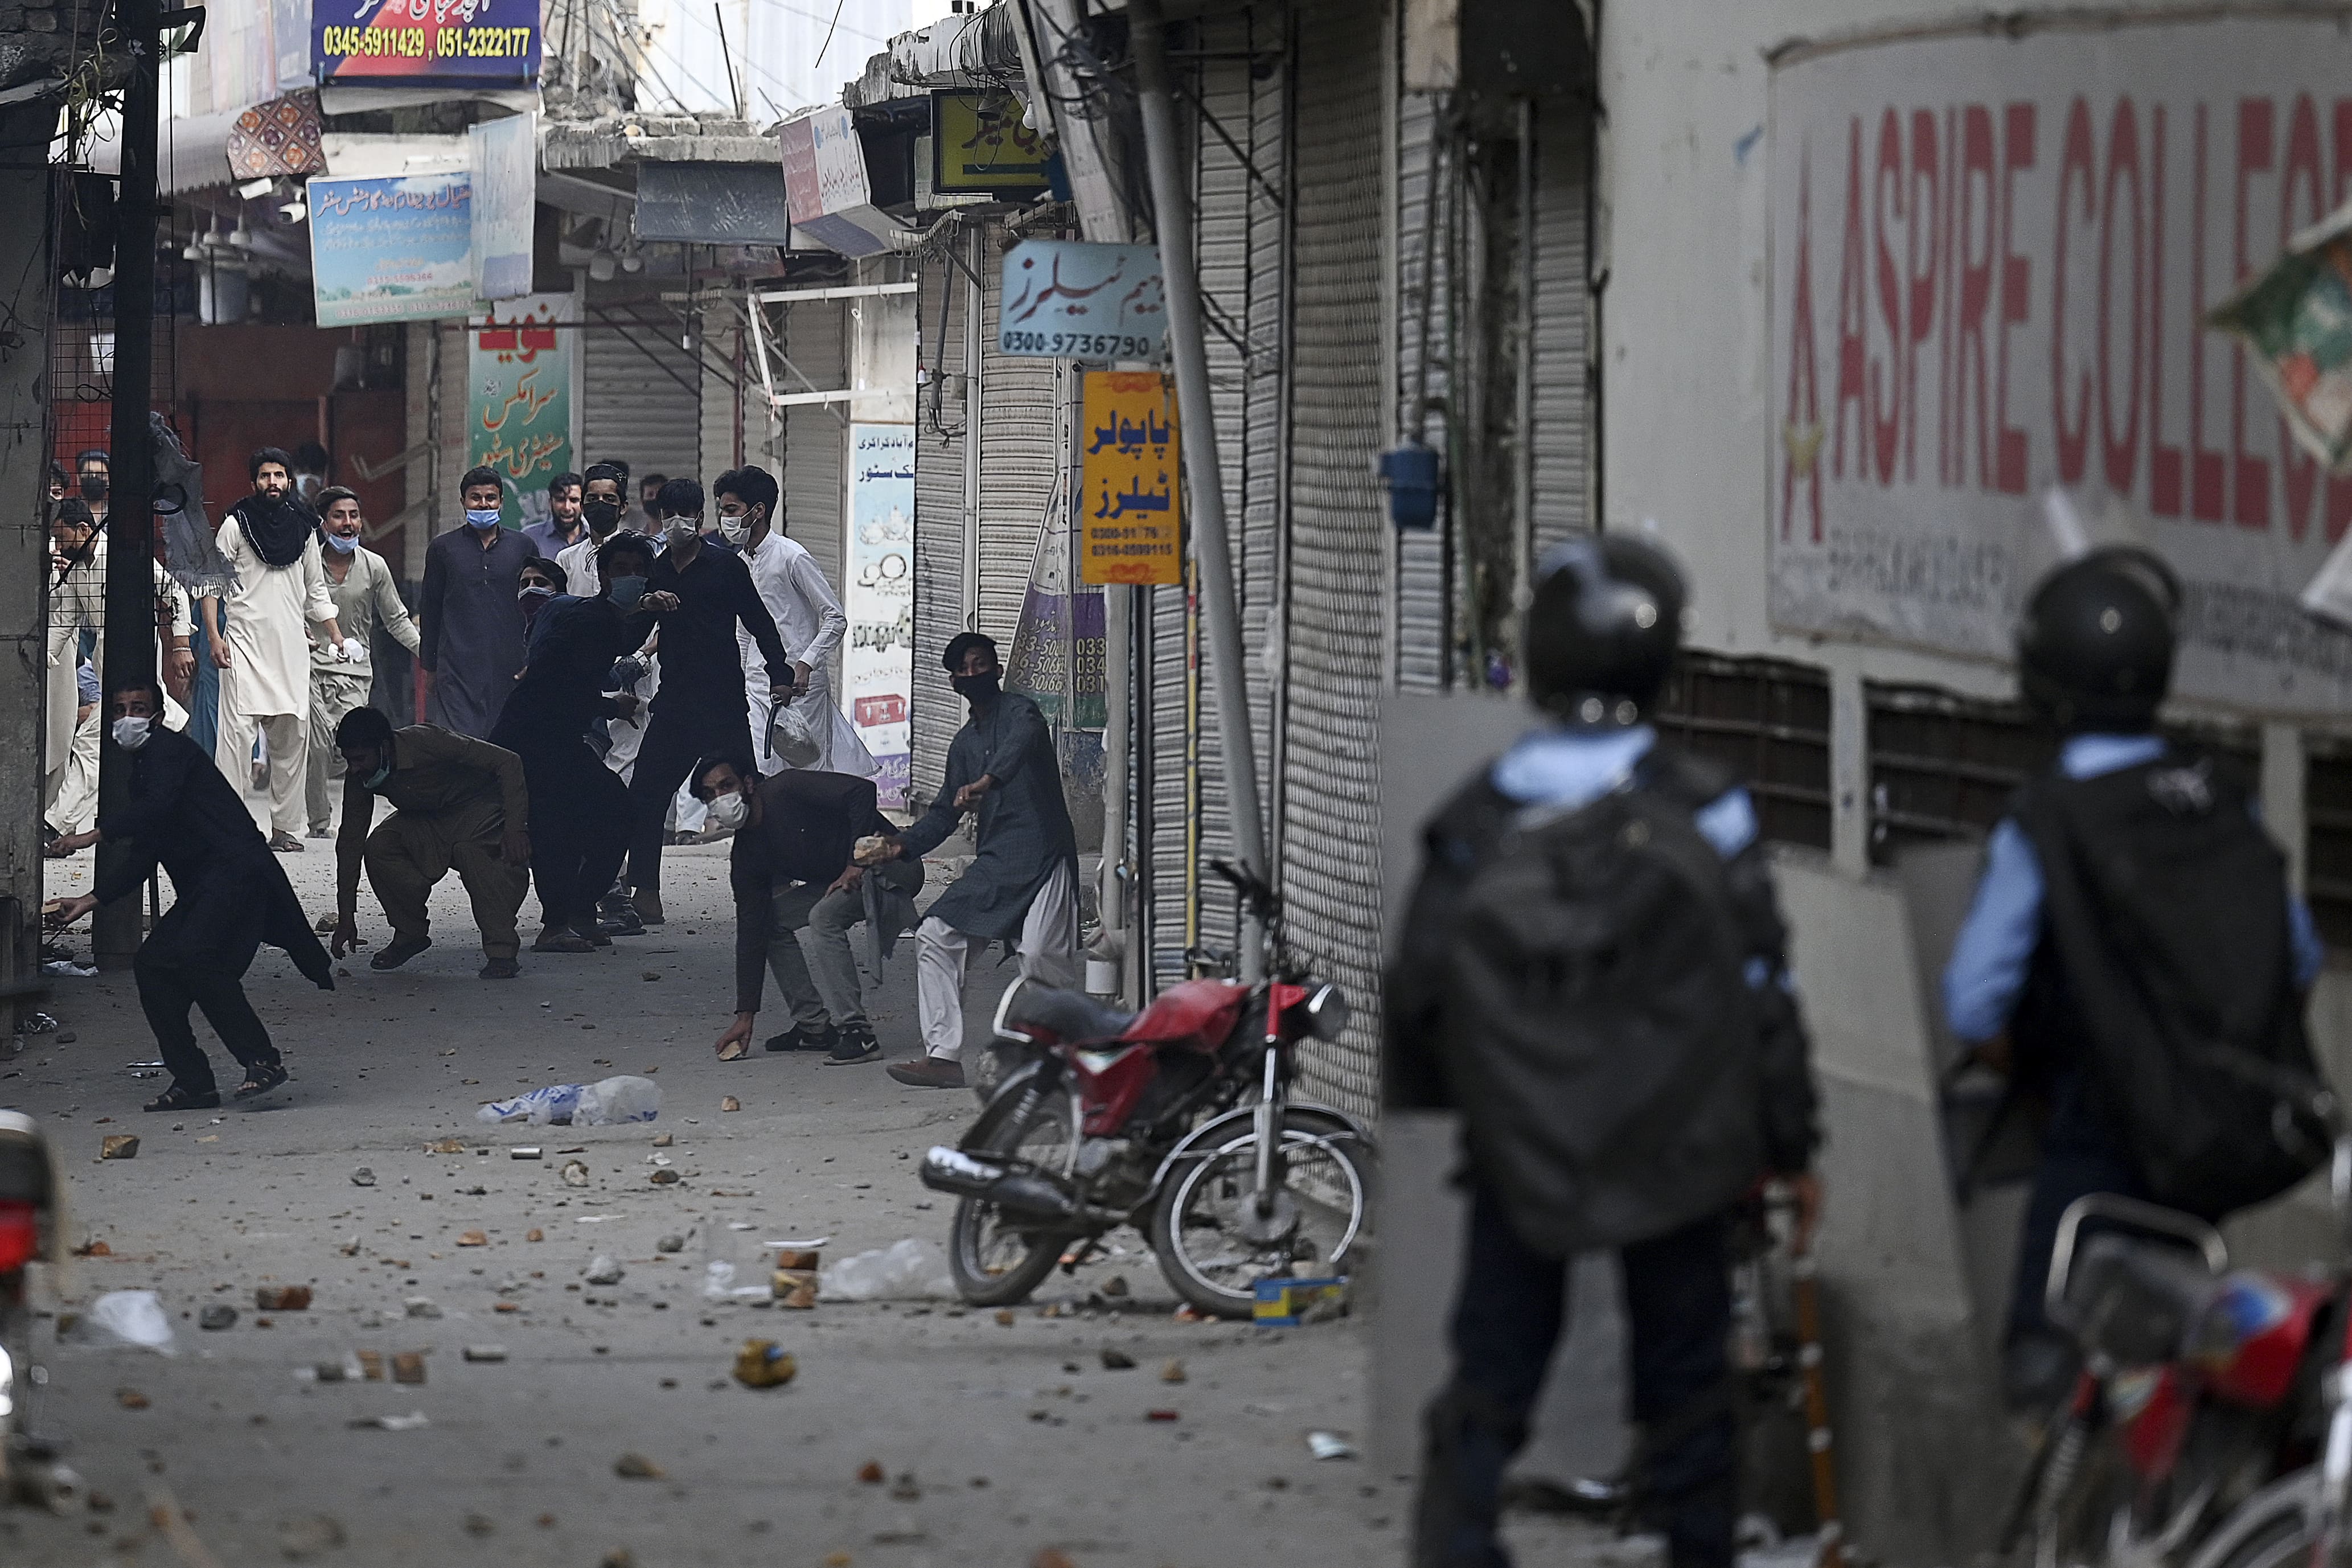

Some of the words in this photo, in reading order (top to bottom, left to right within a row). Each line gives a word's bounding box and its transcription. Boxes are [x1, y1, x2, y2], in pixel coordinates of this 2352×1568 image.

[437, 27, 531, 57] 051-2322177
[1835, 101, 2037, 494] ASPIRE
[478, 302, 557, 363] نوید
[1003, 331, 1150, 356] 0300-9736790
[1087, 408, 1171, 460] پاپولر
[1094, 470, 1171, 519] ٹیلرز
